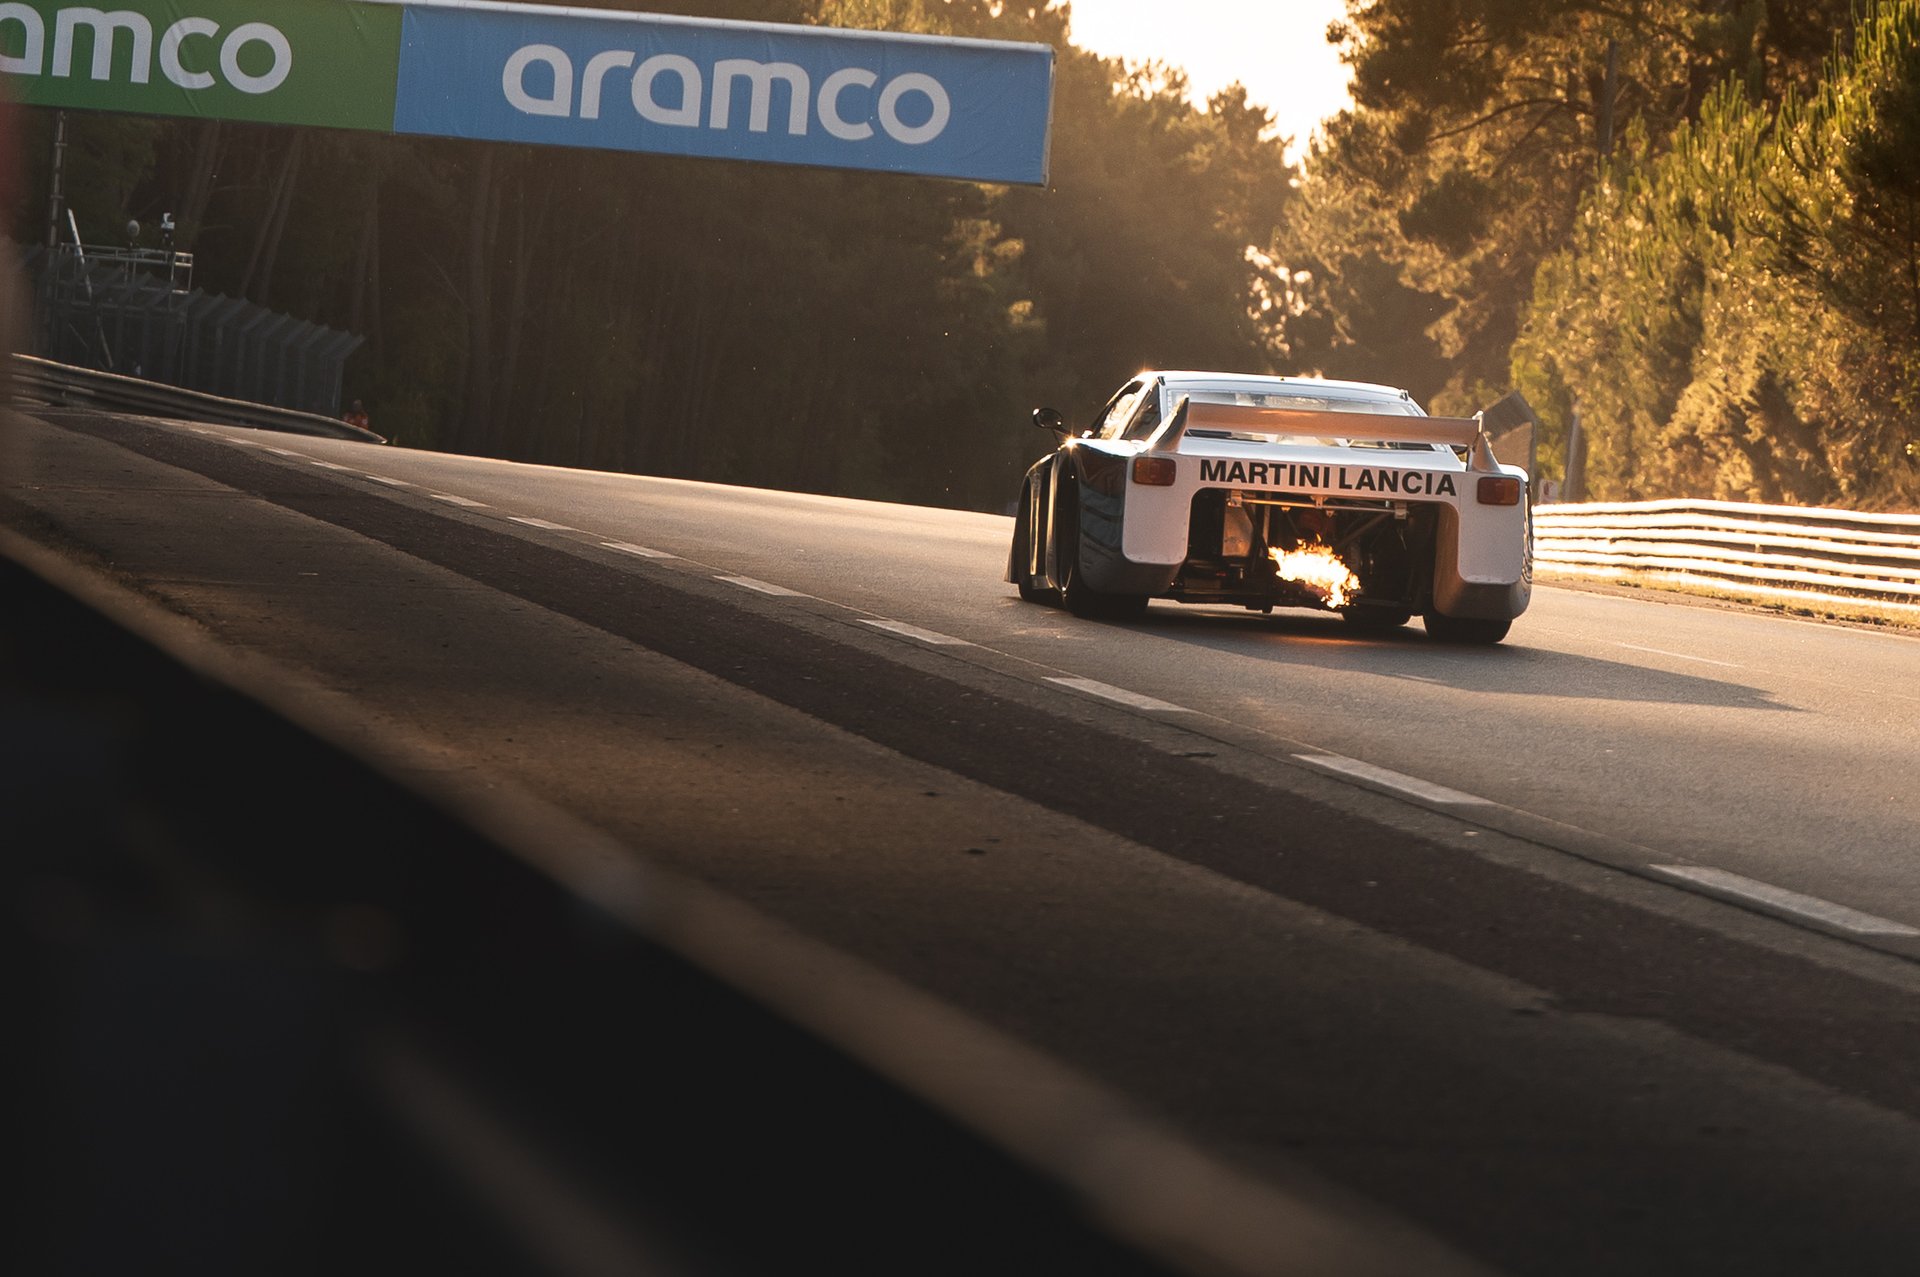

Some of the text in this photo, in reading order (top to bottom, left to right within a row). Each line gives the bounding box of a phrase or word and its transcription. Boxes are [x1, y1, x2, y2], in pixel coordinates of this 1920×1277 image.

[502, 43, 951, 144] aramco
[1200, 459, 1456, 496] MARTINI LANCIA
